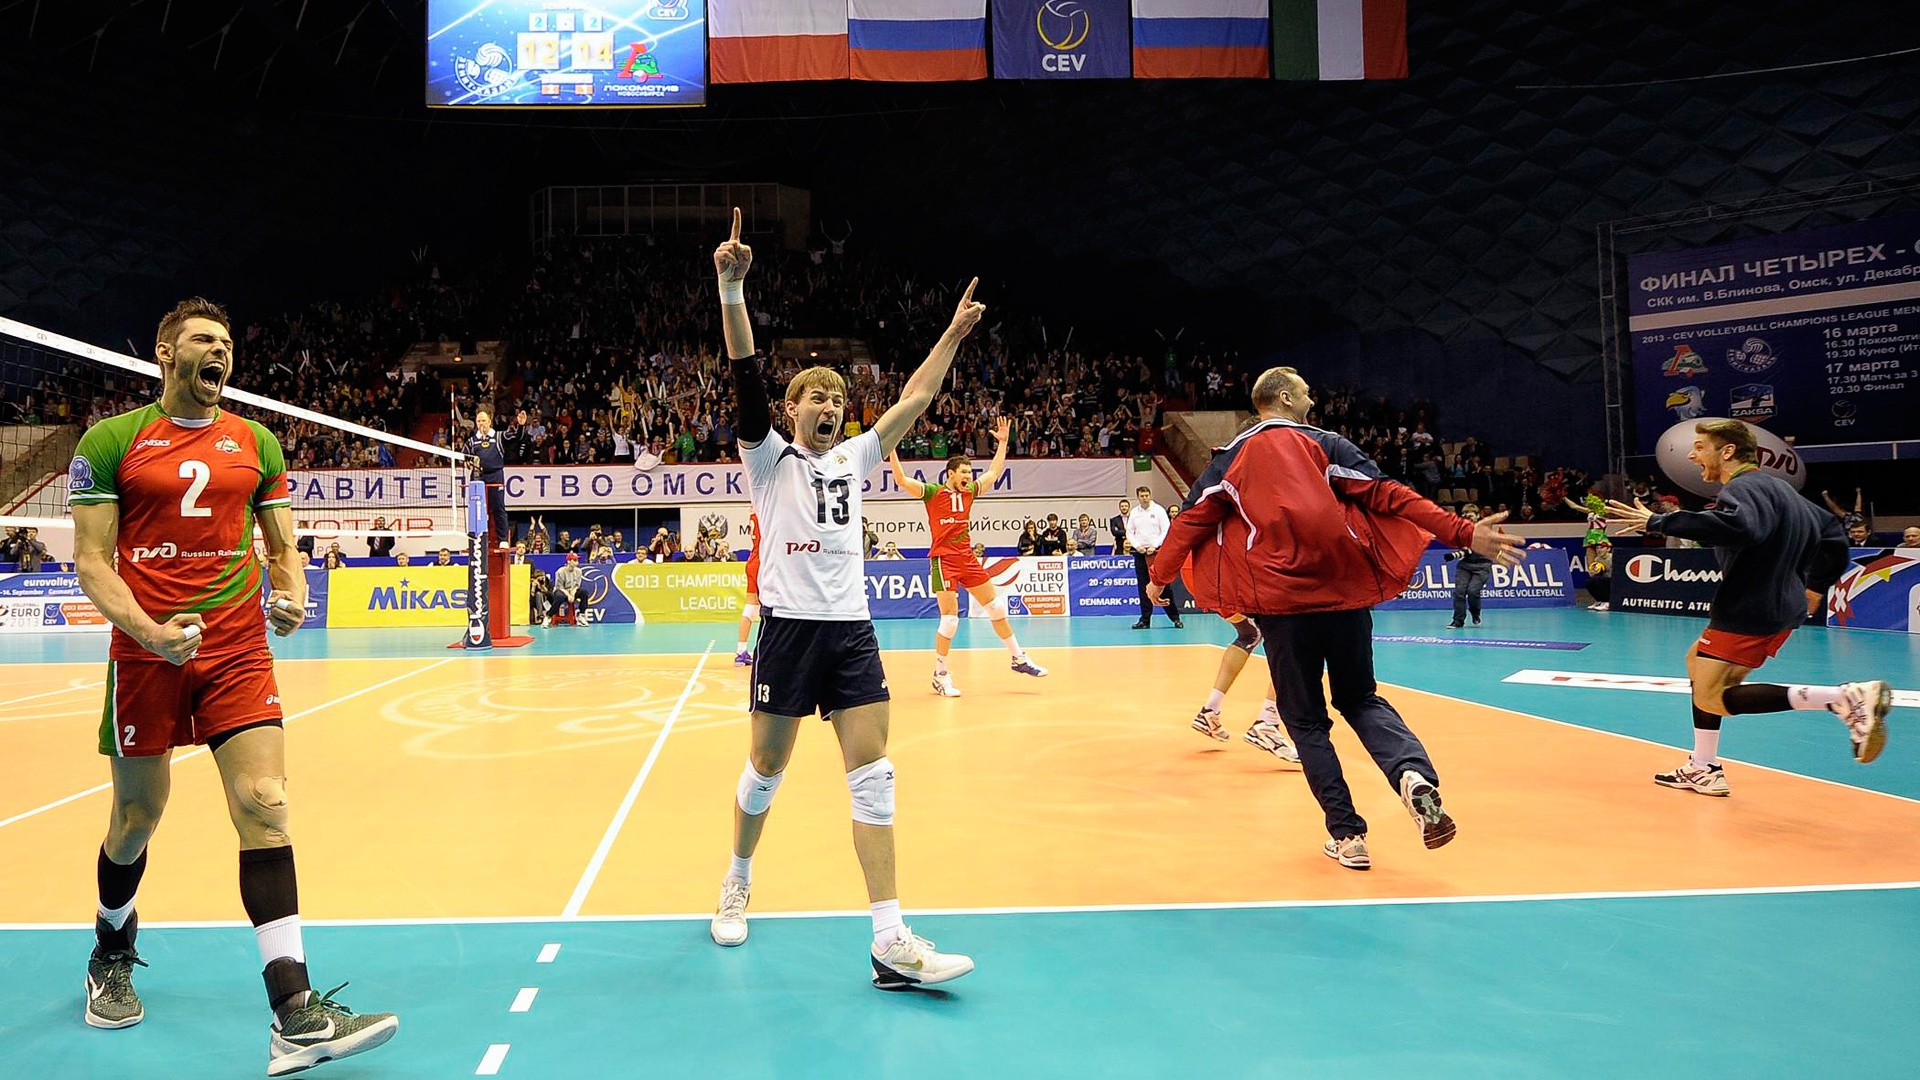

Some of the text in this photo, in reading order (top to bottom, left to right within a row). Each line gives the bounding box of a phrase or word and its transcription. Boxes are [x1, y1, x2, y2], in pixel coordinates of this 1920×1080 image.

[1041, 53, 1087, 72] CEV
[1640, 264, 1735, 291] ФИНАЛ
[1744, 243, 1887, 277] ЧЕТЫРЕХ
[1647, 298, 1674, 308] СКК
[1677, 294, 1700, 304] им.
[1704, 284, 1784, 301] В.Блинова,
[1789, 277, 1832, 290] Омск,
[1836, 274, 1859, 286] ул.
[1642, 336, 1665, 344] 2013
[1673, 332, 1695, 340] CEV
[1696, 322, 1767, 337] VOLLEYBALL
[1769, 314, 1838, 330] CHAMPIONS
[1841, 309, 1890, 321] LEAGUE
[1823, 323, 1898, 338] 16 марта
[1825, 339, 1855, 349] 16.30
[1825, 349, 1856, 359] 19.30
[1825, 359, 1900, 373] 17 марта
[1827, 375, 1857, 385] 17.30
[1860, 373, 1891, 382] Матч
[1830, 382, 1905, 394] 20.30 Финал
[1732, 408, 1773, 417] ZAKSA
[1834, 419, 1856, 427] CEV
[178, 459, 213, 518] 2
[631, 472, 744, 496] ОМСК
[811, 478, 850, 526] 13
[950, 492, 965, 513] 11
[181, 550, 216, 558] Russian
[1071, 560, 1136, 569] EUROVOLLEY2
[625, 574, 659, 588] 2013
[1030, 572, 1064, 582] EURO
[1089, 578, 1098, 586] 20
[1103, 578, 1112, 586] 29
[1015, 582, 1064, 593] VOLLEY
[1402, 589, 1451, 599] FÉDÉRATION
[1516, 588, 1564, 598] VOLLEYBALL
[681, 596, 737, 611] LEAGUE
[1080, 597, 1121, 606] DENMARK
[1129, 597, 1140, 606] PO
[1622, 597, 1711, 611] AUTHENTIC ATH
[11, 608, 40, 617] EURO
[577, 608, 606, 622] EV
[757, 683, 770, 703] 13
[123, 724, 136, 747] 2
